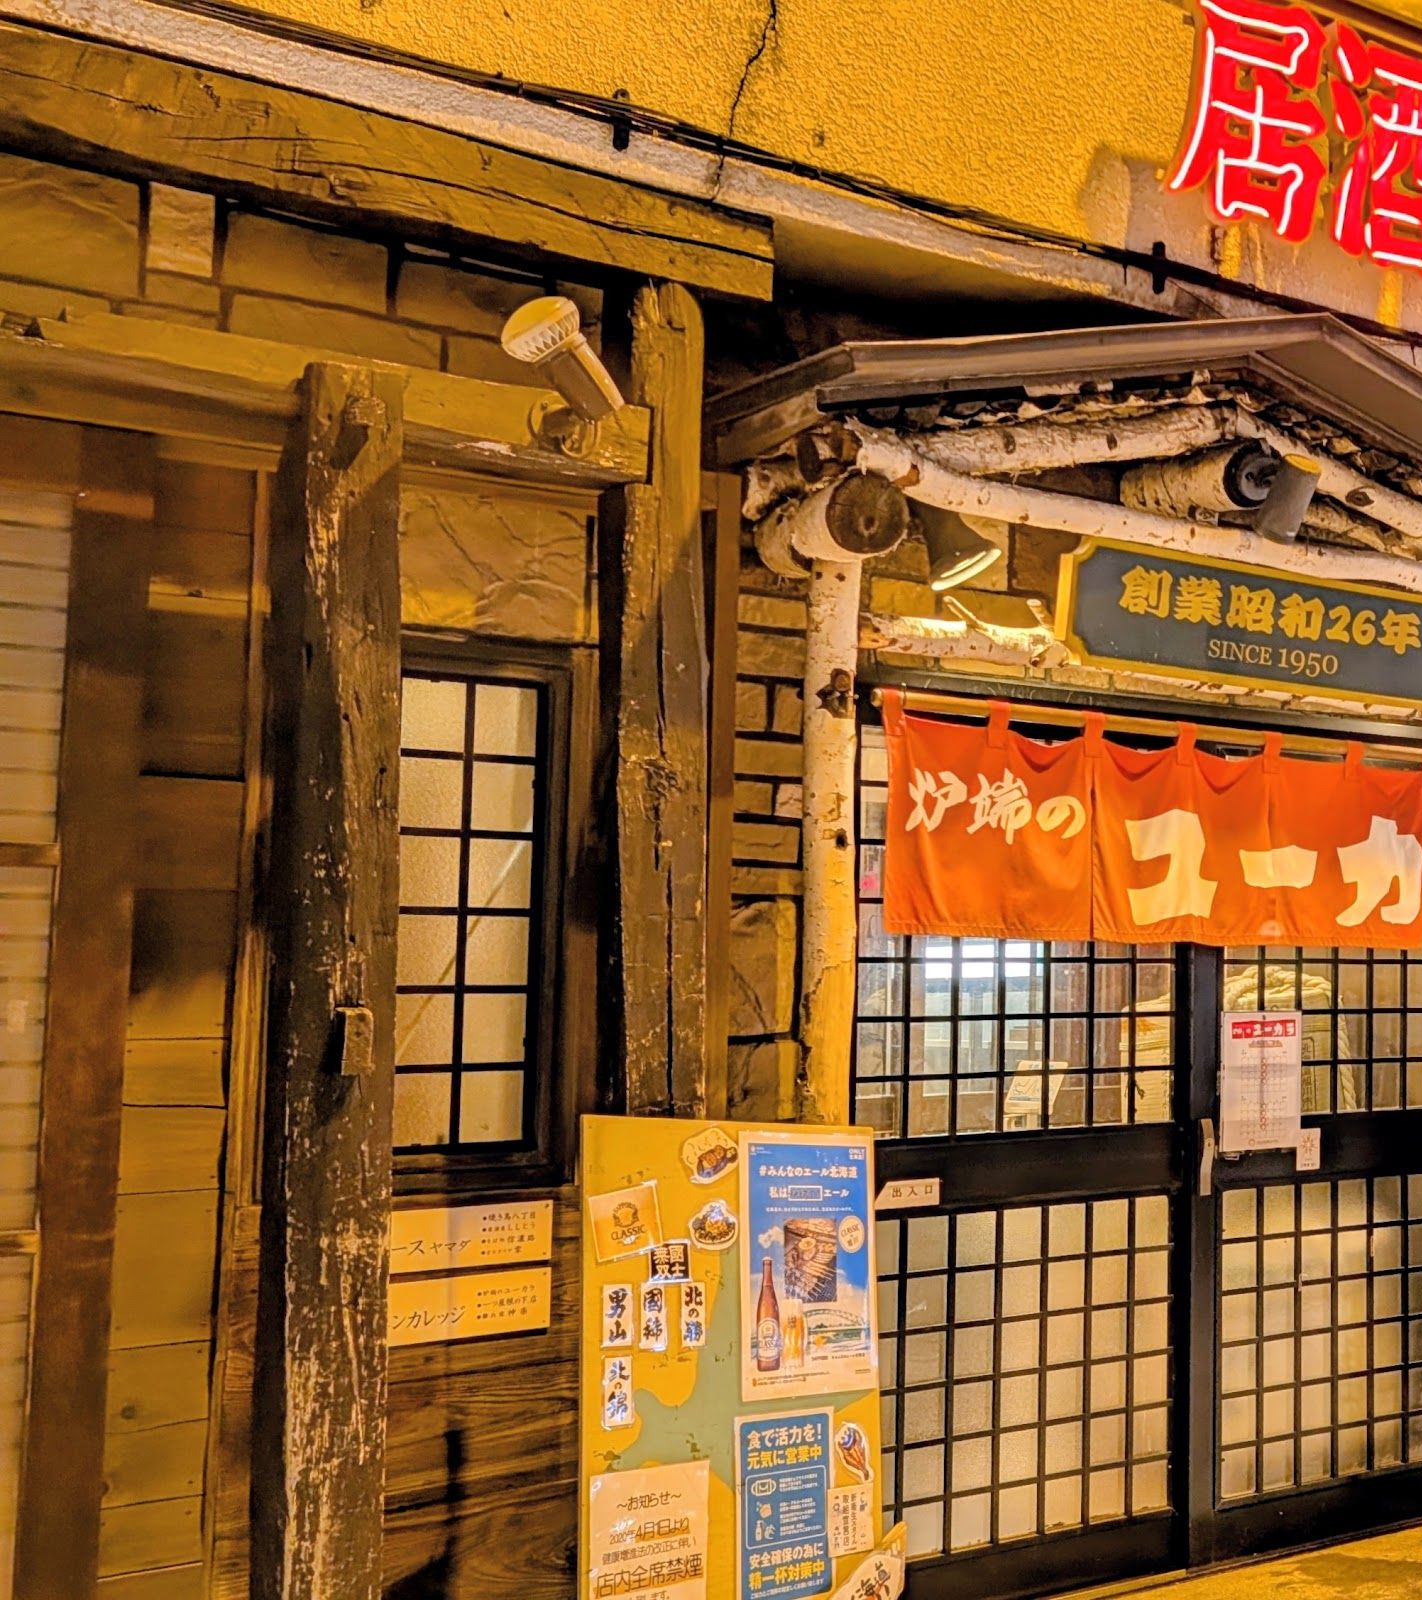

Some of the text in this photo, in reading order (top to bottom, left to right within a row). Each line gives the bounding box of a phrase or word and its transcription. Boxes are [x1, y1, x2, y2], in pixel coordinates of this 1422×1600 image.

[1119, 566, 1422, 656] 創業昭和26年
[1207, 637, 1339, 678] SINCE 1950
[904, 768, 1087, 846] 炉端の
[823, 1189, 850, 1198] エール
[891, 1184, 934, 1199] 出入口
[610, 1224, 646, 1242] CLASSIC
[605, 1288, 629, 1344] 男山
[747, 1423, 823, 1450] 食で活力を!
[747, 1444, 823, 1470] 元気に営業中
[749, 1542, 824, 1570] 安全確保の為に
[595, 1553, 704, 1600] 店内全席禁煙
[748, 1560, 825, 1591] 精一杯対策中
